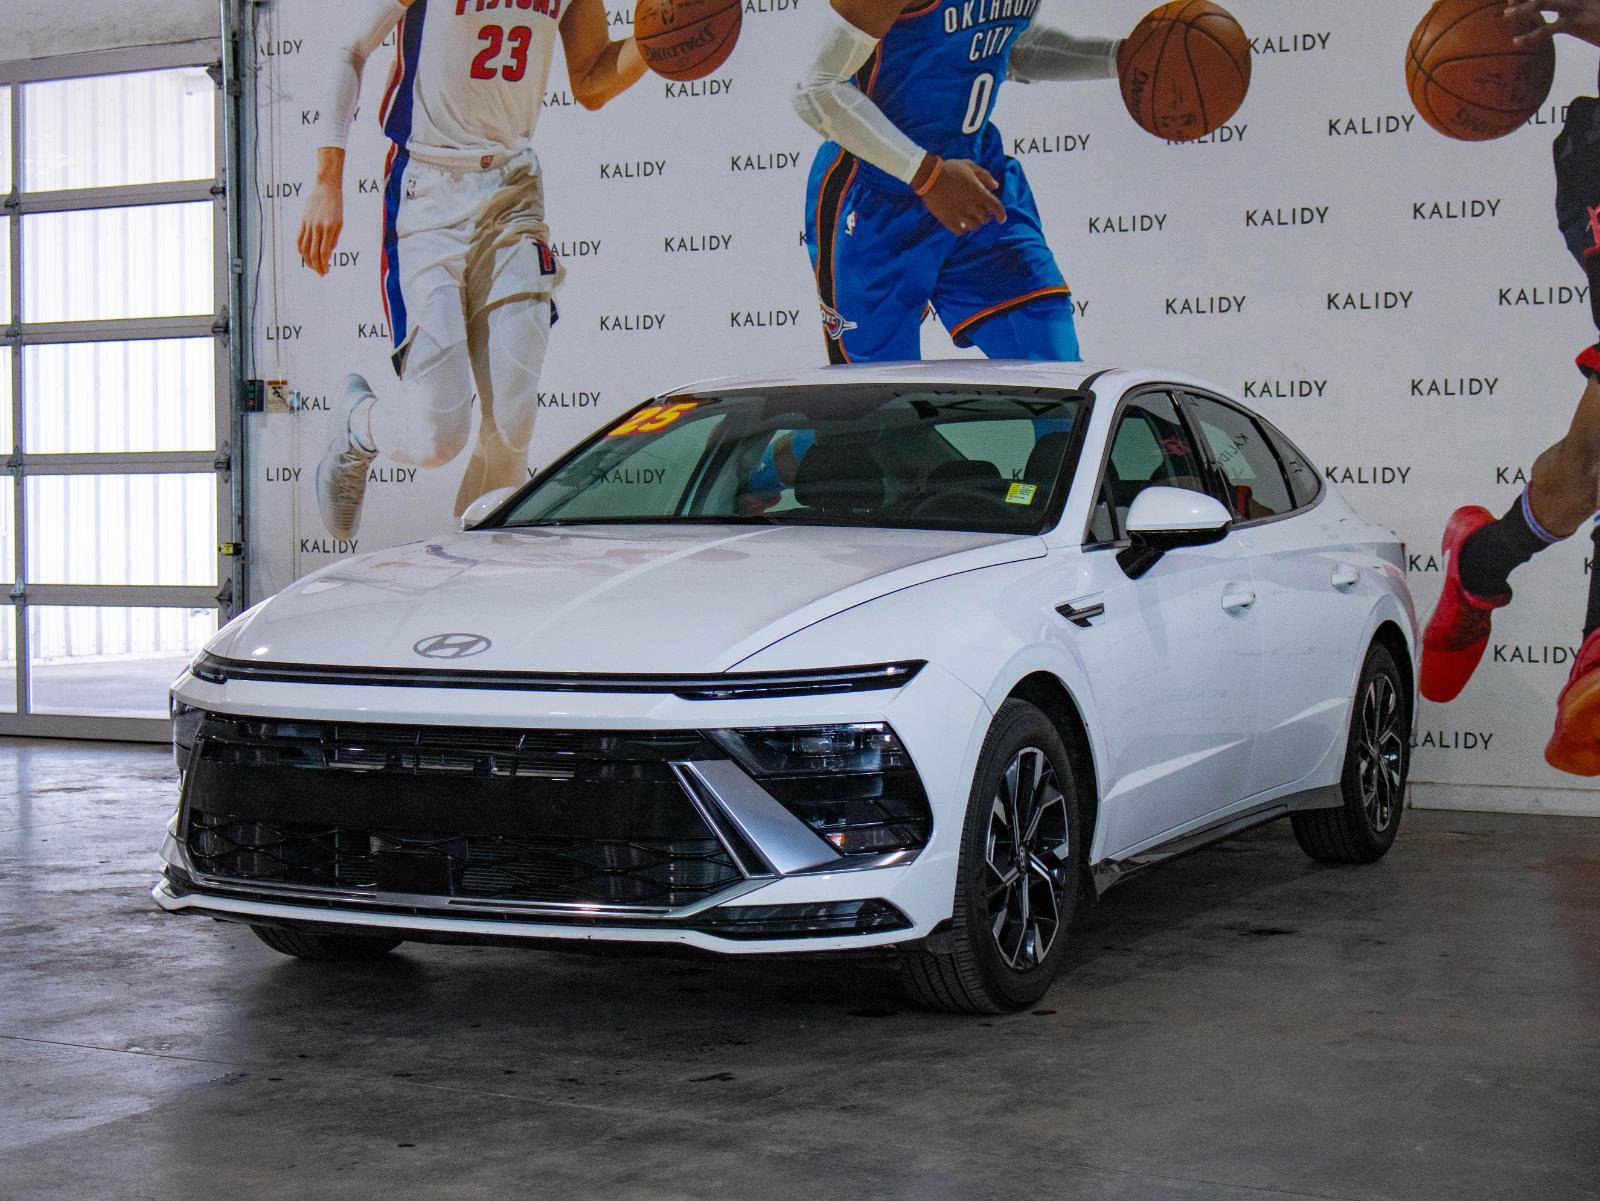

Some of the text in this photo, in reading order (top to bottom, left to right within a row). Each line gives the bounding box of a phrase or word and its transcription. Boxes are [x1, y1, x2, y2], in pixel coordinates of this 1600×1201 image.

[470, 24, 533, 82] 23
[968, 26, 1014, 61] CITY
[665, 78, 733, 98] KALIDY
[961, 72, 995, 135] 0
[1329, 114, 1415, 137] KALIDY
[1013, 134, 1091, 155] KALIDY
[600, 160, 666, 179] KALIDY
[732, 151, 801, 172] KALIDY
[1246, 206, 1329, 227] KALIDY
[1414, 199, 1501, 220] KALIDY
[1089, 213, 1168, 234] KALIDY
[664, 235, 733, 253] KALIDY
[1165, 295, 1246, 315] KALIDY
[1327, 291, 1414, 311] KALIDY
[1499, 286, 1589, 306] KALIDY
[600, 313, 666, 331] KALIDY
[730, 310, 800, 328] KALIDY
[1244, 379, 1328, 398] KALIDY
[1412, 378, 1499, 396] KALIDY
[536, 392, 601, 408] KALIDY
[607, 402, 700, 437] 25
[601, 468, 665, 484] KALIDY
[1325, 466, 1411, 485] KALIDY
[301, 538, 359, 554] KALIDY
